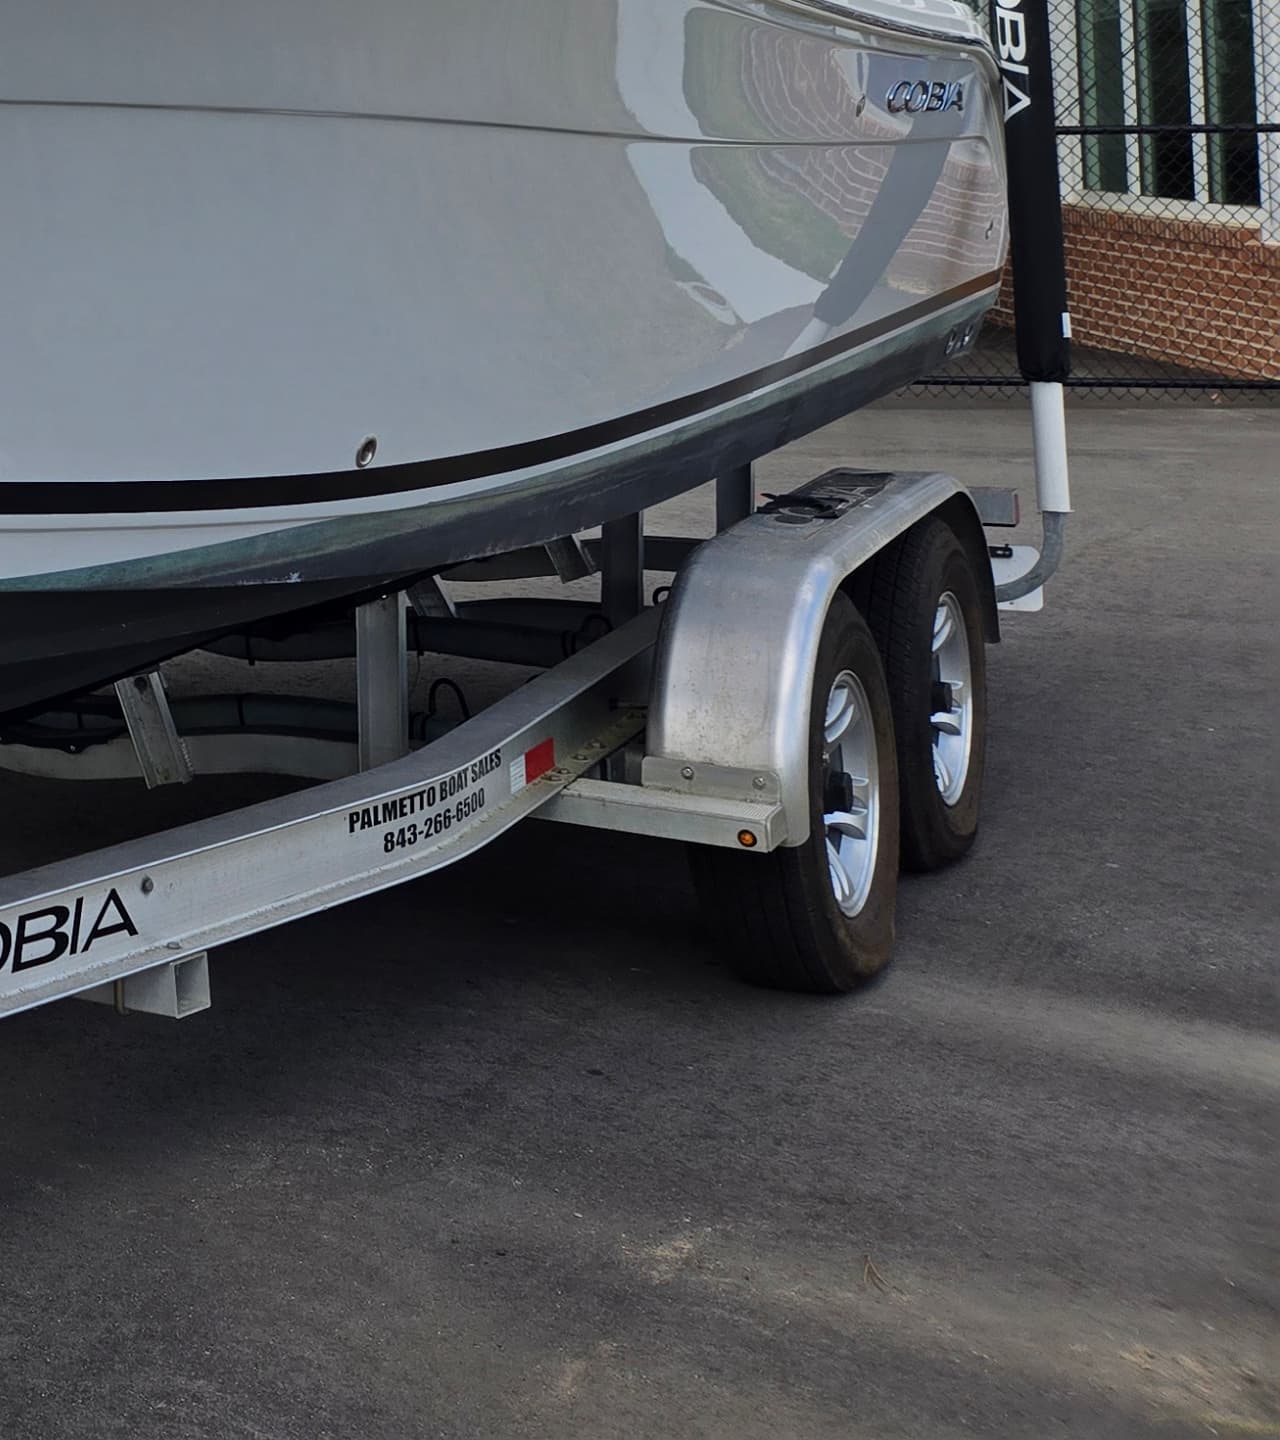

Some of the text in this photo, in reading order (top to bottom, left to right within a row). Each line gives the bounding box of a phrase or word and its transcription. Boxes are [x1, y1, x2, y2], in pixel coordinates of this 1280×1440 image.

[885, 80, 964, 114] COBIA
[348, 748, 503, 834] PALMETTO BOAT SALES
[383, 787, 486, 854] 843-266-6500
